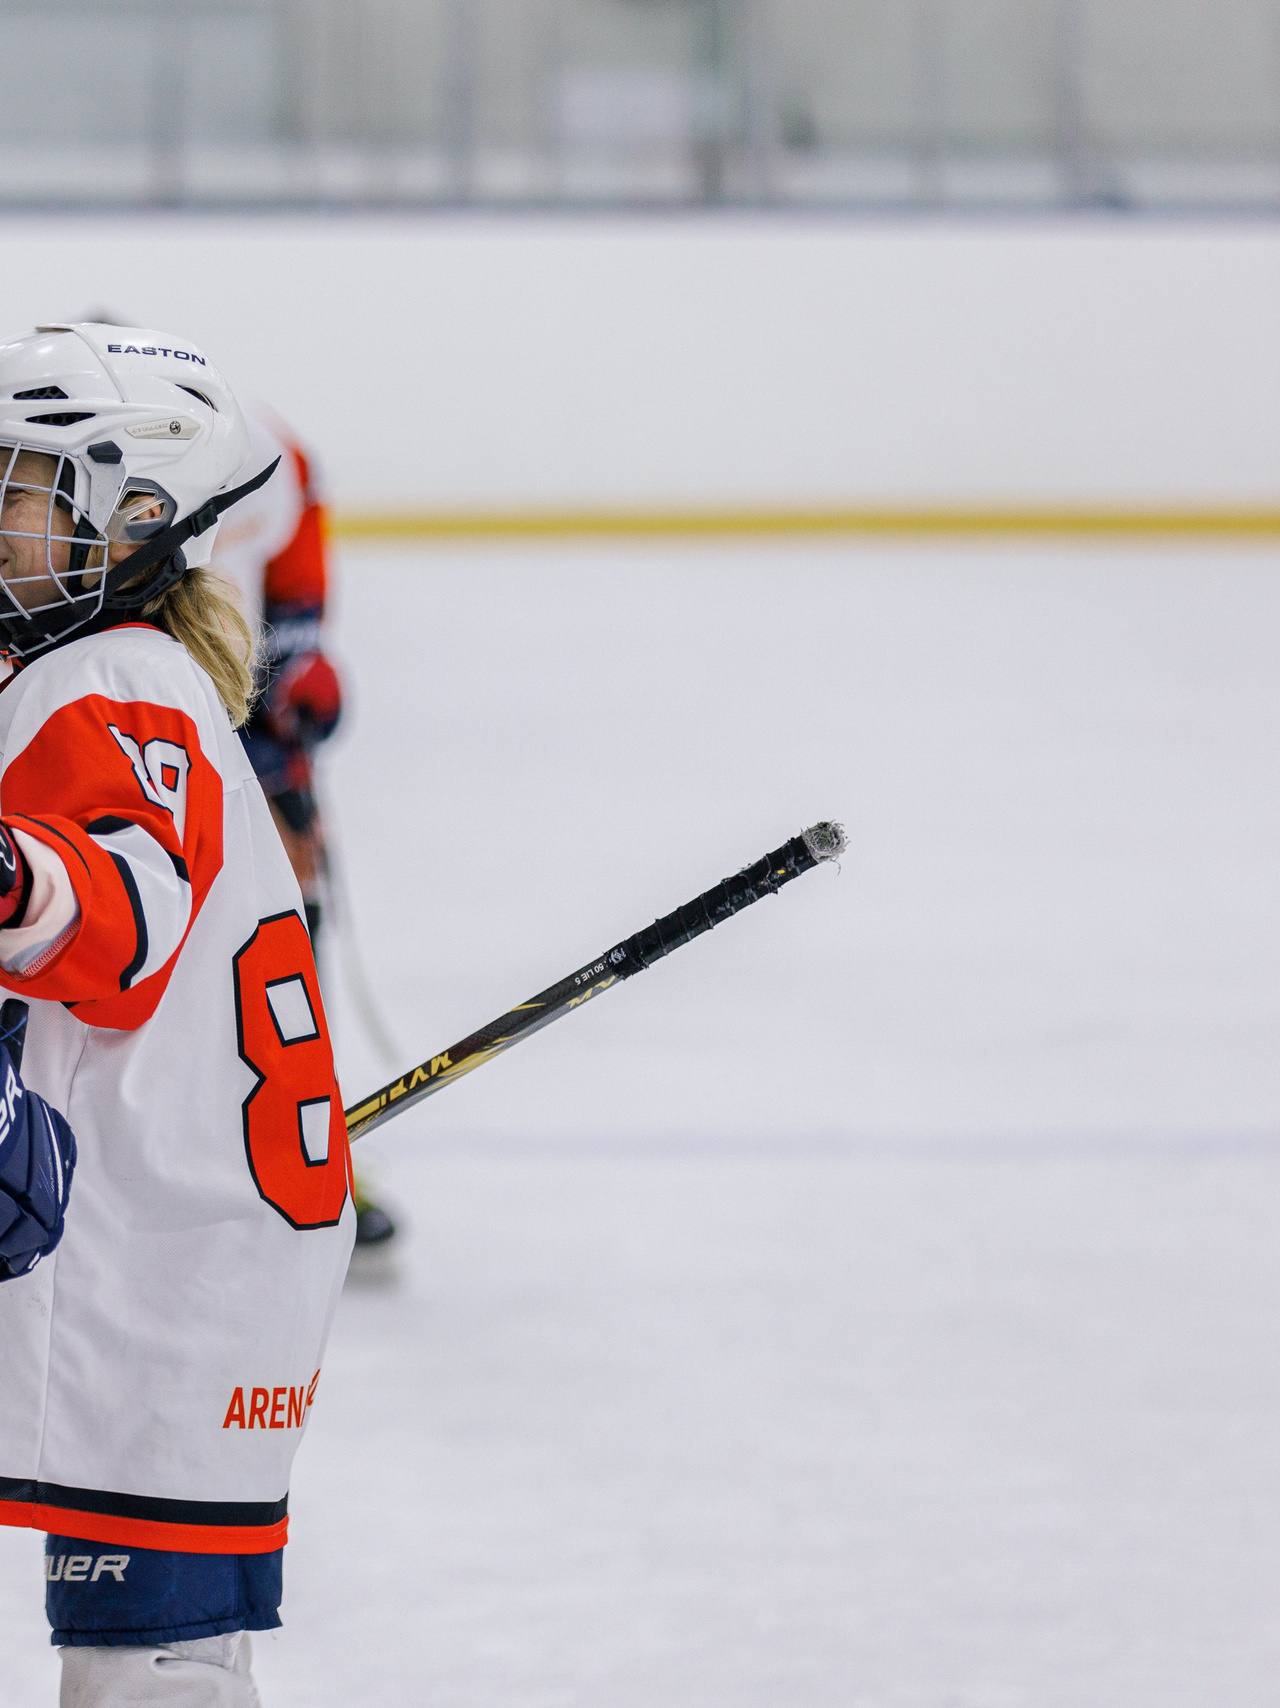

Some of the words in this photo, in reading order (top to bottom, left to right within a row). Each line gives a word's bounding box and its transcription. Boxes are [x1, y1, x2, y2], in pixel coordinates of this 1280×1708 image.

[107, 344, 207, 367] EASTON
[232, 908, 353, 1231] 8
[222, 1386, 311, 1429] AREN
